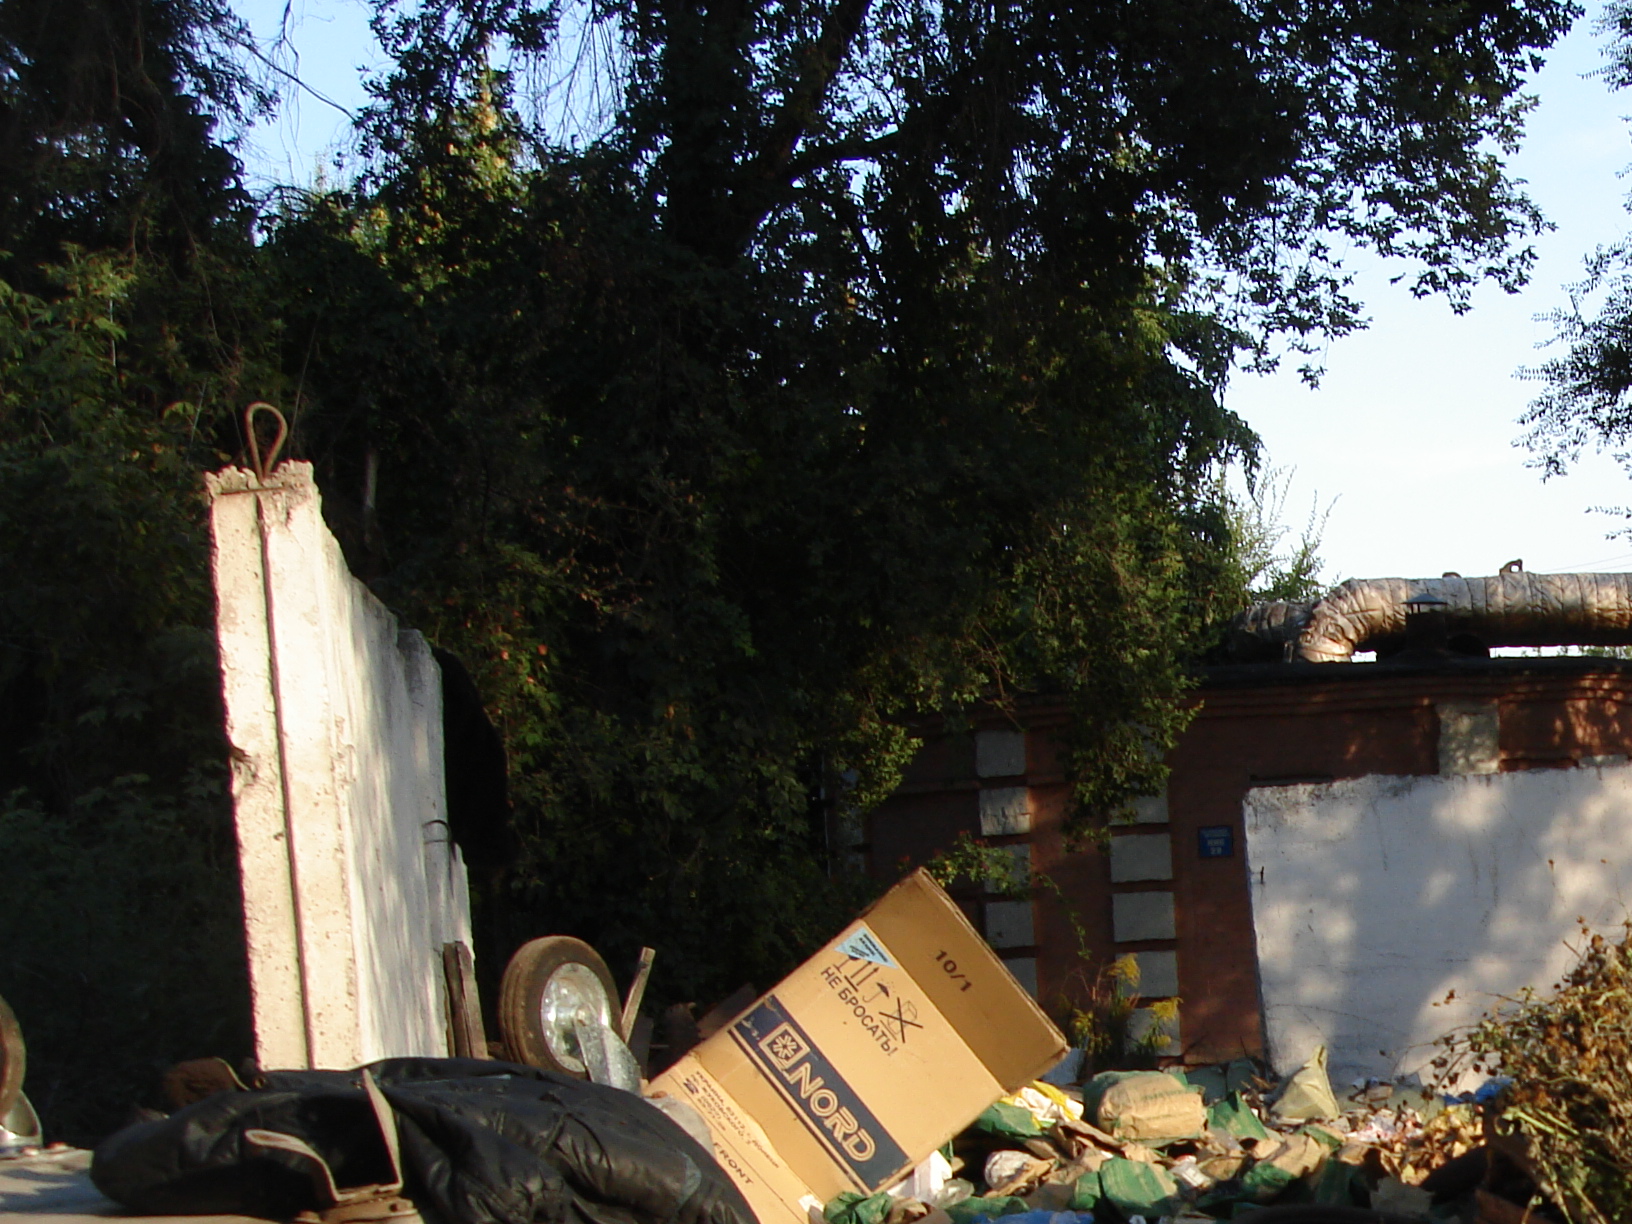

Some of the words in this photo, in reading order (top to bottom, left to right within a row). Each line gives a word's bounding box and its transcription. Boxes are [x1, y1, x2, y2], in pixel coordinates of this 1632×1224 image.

[935, 949, 973, 993] 10/1
[820, 966, 843, 990] НЕ
[837, 987, 899, 1057] БРОСАТЬ!
[786, 1060, 876, 1163] NORD
[712, 1141, 755, 1184] FRONT
